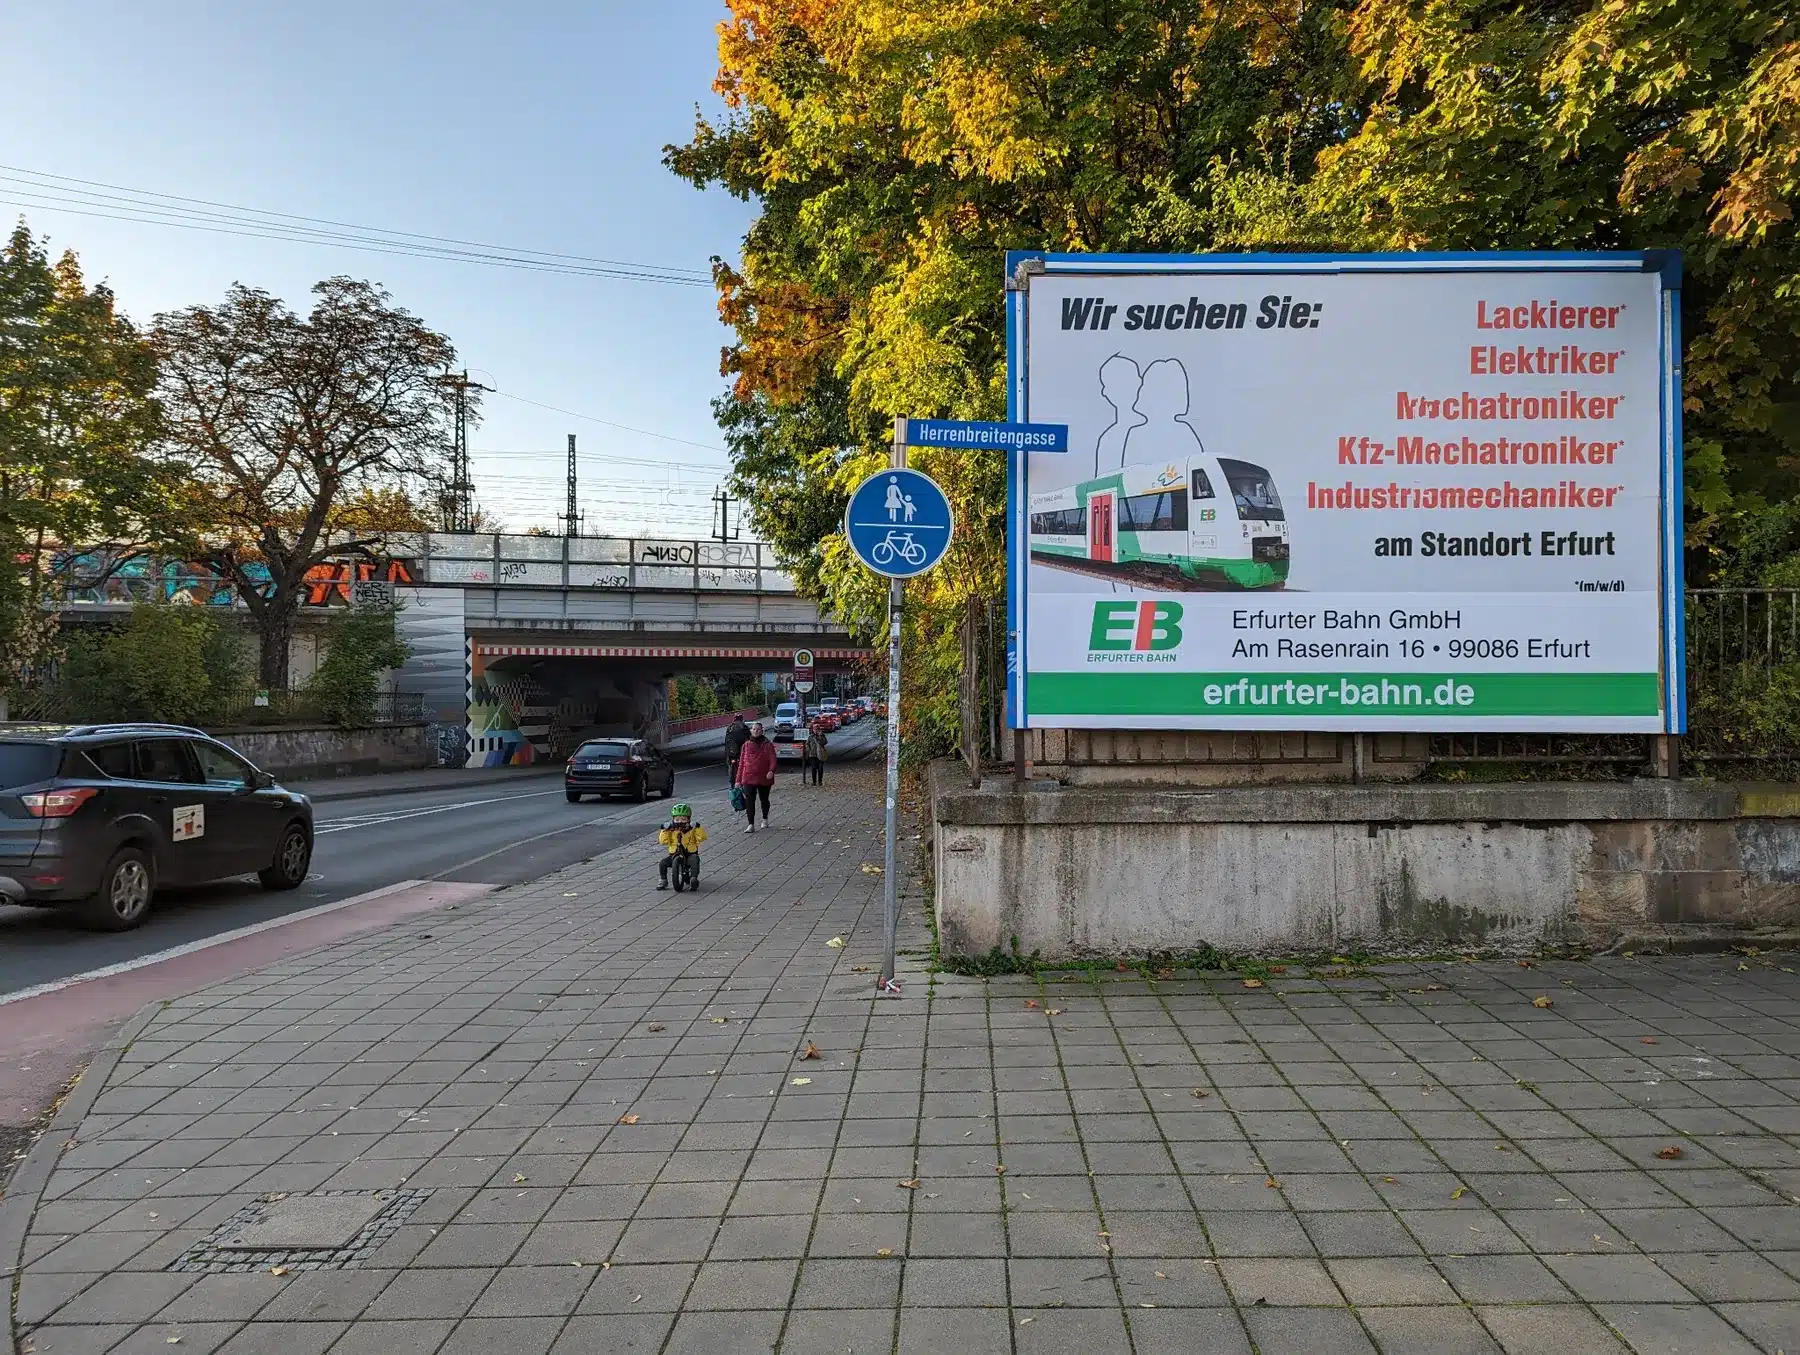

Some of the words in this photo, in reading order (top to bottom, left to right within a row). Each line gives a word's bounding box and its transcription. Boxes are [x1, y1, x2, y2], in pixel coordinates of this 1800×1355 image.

[1061, 298, 1118, 331] Wir
[1124, 297, 1248, 331] suchen
[1255, 295, 1323, 330] Sie:
[920, 423, 1056, 449] Herrenbreitengasse
[1374, 537, 1413, 557] am
[1420, 531, 1532, 557] Standort
[1540, 530, 1616, 556] Erfurt
[1088, 600, 1184, 651] EB
[1233, 609, 1316, 629] Erfurter
[1323, 610, 1381, 629] Bahn
[1389, 609, 1461, 630] GmbH
[1087, 653, 1144, 662] ERFURTER
[1146, 653, 1177, 662] BAHN
[1231, 639, 1268, 658] Am
[1278, 639, 1389, 658] Rasenrain
[1398, 639, 1425, 658] 16
[1448, 639, 1519, 659] 99086
[1528, 638, 1591, 658] Erfurt
[1203, 678, 1475, 706] erfurter-bahn.de
